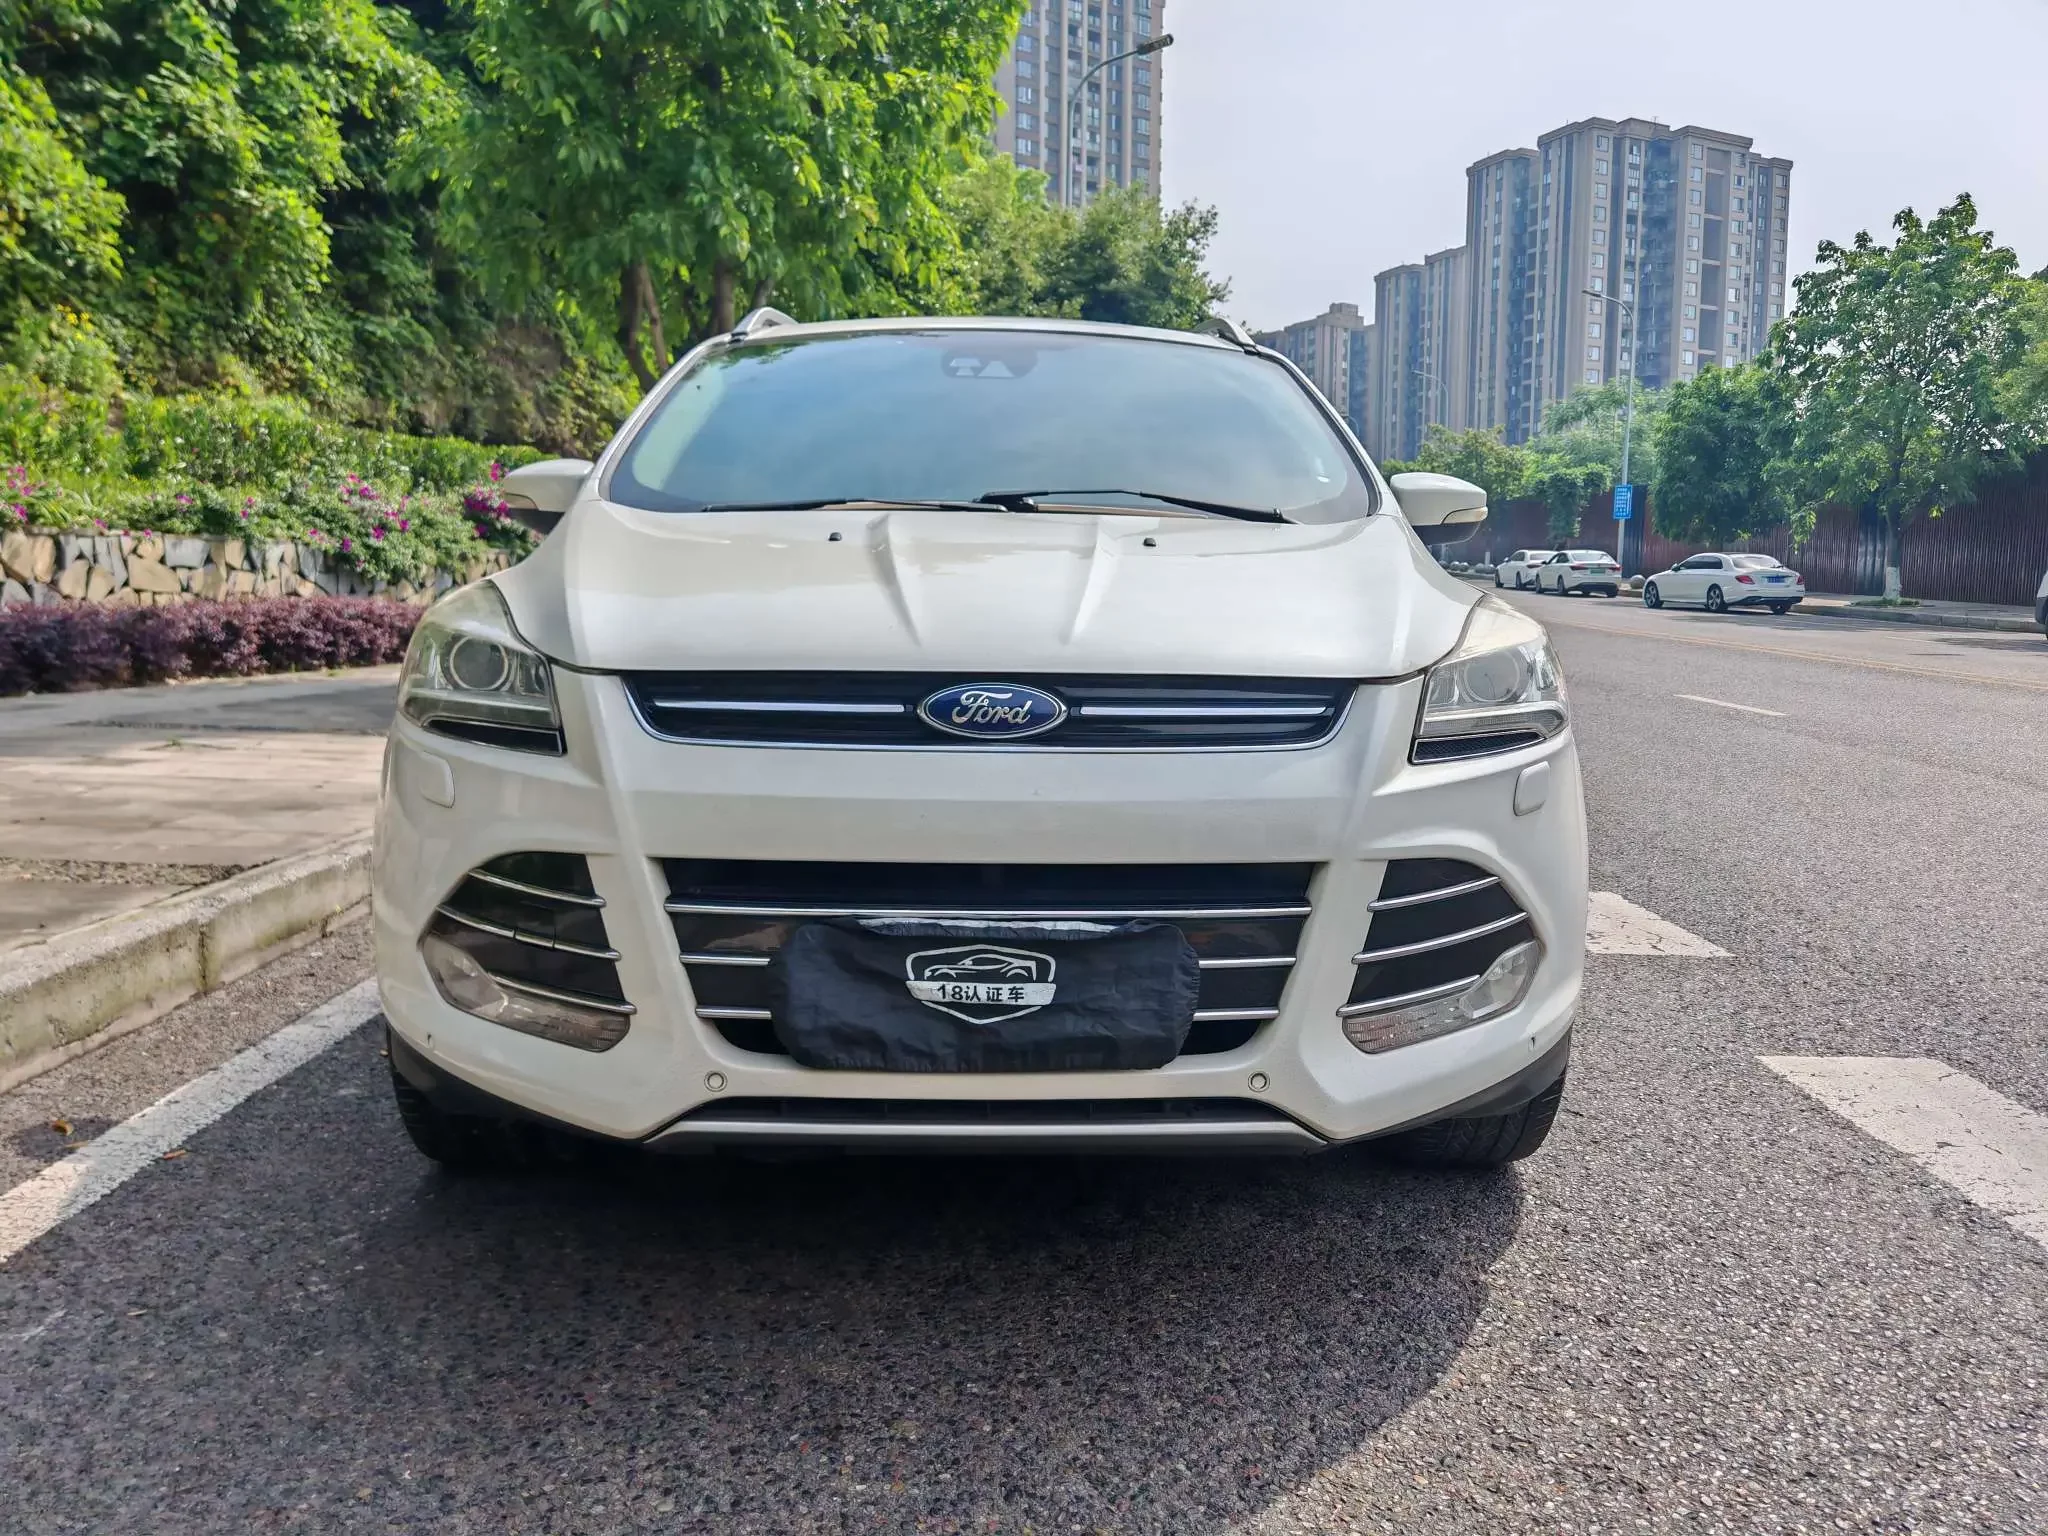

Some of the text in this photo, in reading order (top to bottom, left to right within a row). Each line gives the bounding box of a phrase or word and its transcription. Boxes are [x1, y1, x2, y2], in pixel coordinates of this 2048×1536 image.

[952, 691, 1033, 724] Ford
[937, 984, 1025, 1003] 18认证车
